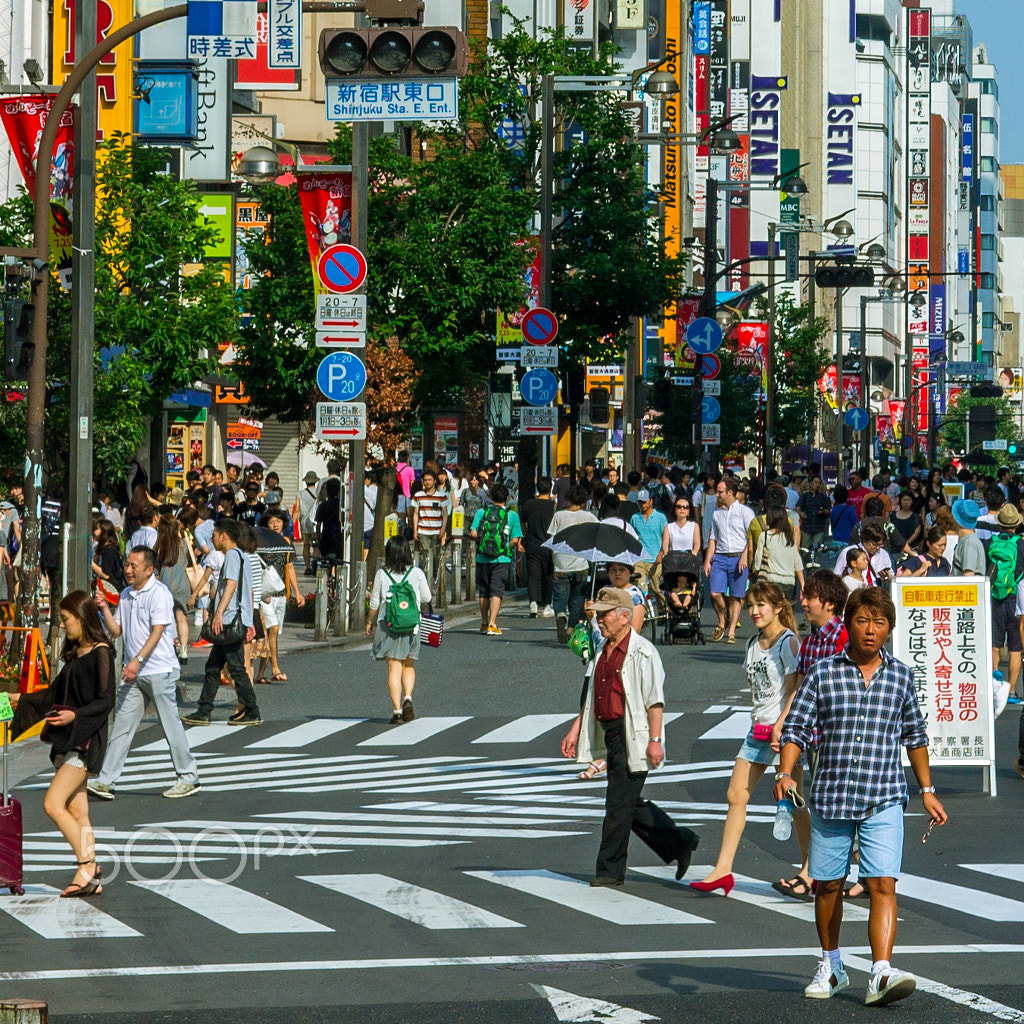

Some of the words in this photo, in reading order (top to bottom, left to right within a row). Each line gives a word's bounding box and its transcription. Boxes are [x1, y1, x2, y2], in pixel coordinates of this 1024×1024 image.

[190, 36, 255, 58] 時差式
[337, 83, 445, 104] 新宿駅東口
[333, 103, 383, 116] Shinjuku
[387, 103, 410, 114] Sta.
[414, 103, 425, 114] E.
[429, 102, 452, 114] Ent.
[751, 74, 789, 176] ISETAN
[731, 196, 742, 204] 4F
[934, 297, 943, 335] MIZUHO
[328, 363, 347, 394] P
[341, 380, 355, 394] 20
[529, 377, 543, 400] P
[904, 590, 975, 604] 自転車走行禁止
[932, 607, 954, 723] 販売や人寄せ行為
